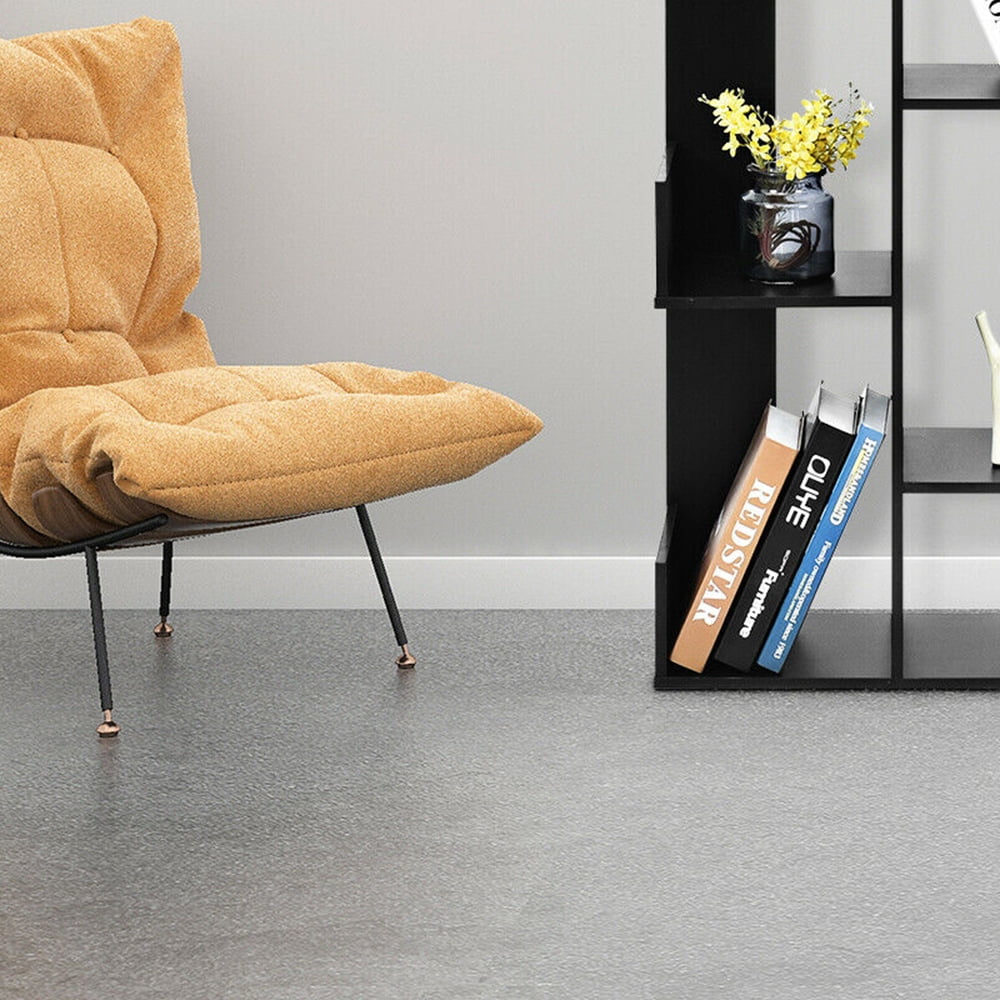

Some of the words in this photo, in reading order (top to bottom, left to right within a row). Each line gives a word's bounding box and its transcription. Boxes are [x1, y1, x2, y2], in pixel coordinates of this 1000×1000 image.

[786, 454, 831, 529] OUYE
[692, 479, 777, 626] REDSTAR
[739, 569, 778, 639] Furniture
